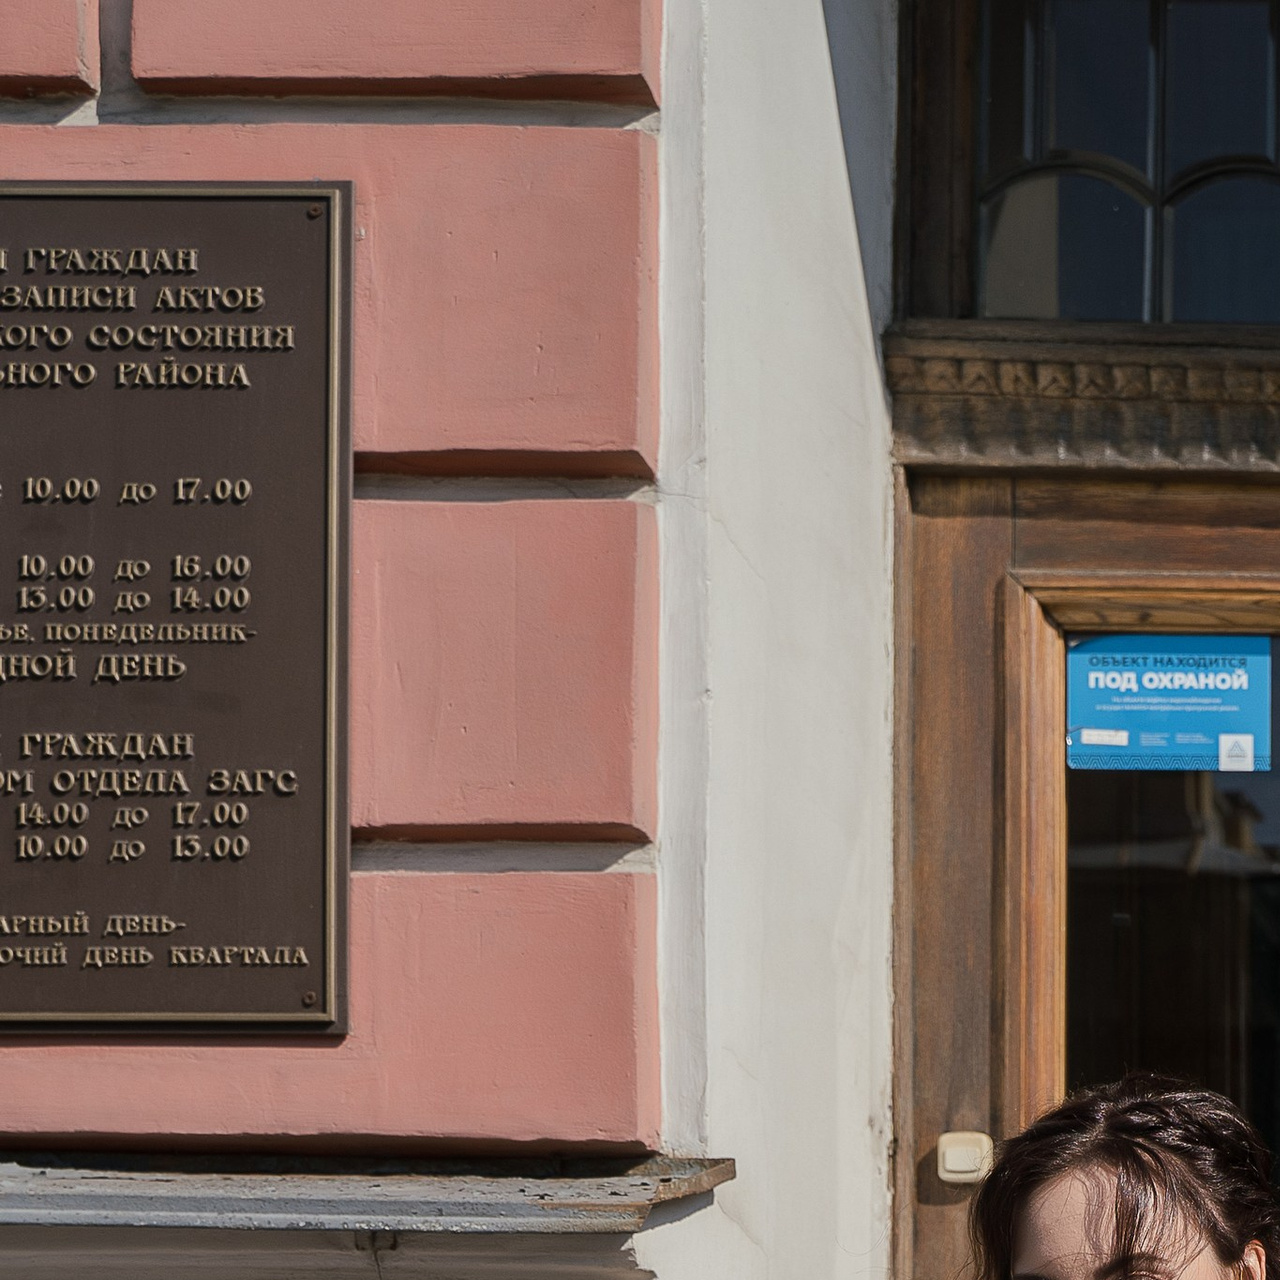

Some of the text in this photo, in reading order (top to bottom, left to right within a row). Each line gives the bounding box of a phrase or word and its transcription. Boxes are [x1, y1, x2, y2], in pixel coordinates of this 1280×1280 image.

[29, 248, 198, 274] ГРАЖДАН
[2, 286, 265, 308] ЗАПИСИ АКТОВ
[0, 325, 294, 348] ОГО СОСТОЯНИЯ
[119, 357, 251, 386] РАЙОНА
[27, 478, 252, 502] 10.00 до 17.00
[23, 555, 251, 579] 10.00 до 16.00
[22, 586, 250, 611] 13.00 до 14.00
[95, 654, 186, 681] ДЕНЬ
[1088, 656, 1247, 668] ОБЪЕКТ НАХОДИТСЯ
[1088, 668, 1248, 692] ПОД ОХРАНОЙ
[24, 733, 194, 759] ГРАЖДАН
[54, 769, 190, 796] ОТДЕЛА
[210, 769, 298, 791] ЗАГС
[20, 802, 248, 827] 14.00 до 17.00
[20, 835, 250, 860] 10.00 до 13.00
[83, 947, 153, 967] ДЕНЬ
[171, 946, 309, 963] КВАРТАЛА
